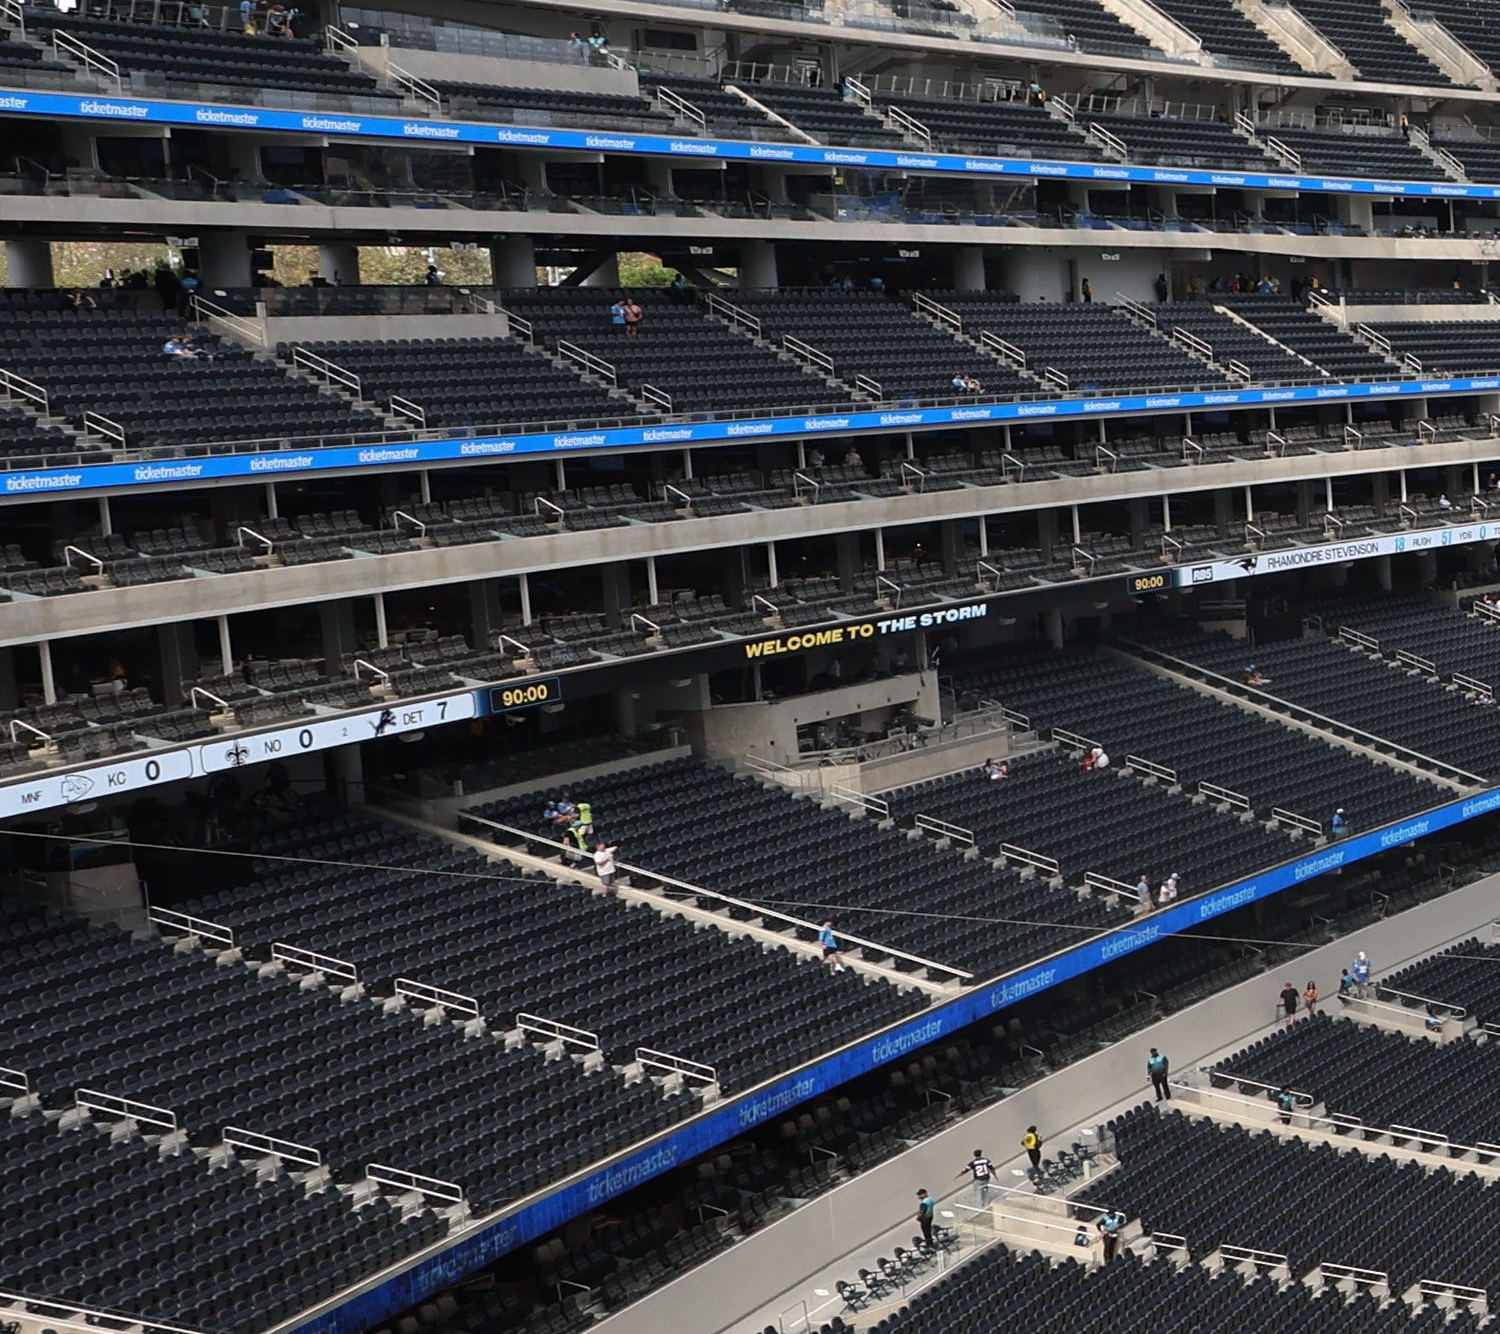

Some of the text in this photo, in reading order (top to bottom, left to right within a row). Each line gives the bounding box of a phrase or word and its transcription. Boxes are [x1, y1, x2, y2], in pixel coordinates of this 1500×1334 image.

[79, 100, 150, 118] ticketmaster
[669, 141, 718, 154] ticketmaster
[459, 441, 517, 455] ticketmaster
[249, 456, 314, 471] ticketmaster
[1394, 533, 1405, 552] 18
[1441, 530, 1452, 546] 51
[1479, 524, 1487, 540] 0
[1268, 541, 1379, 570] RHAMONDRE STEVENSON
[1135, 575, 1164, 590] 90:00
[745, 603, 987, 659] WELCOME TO THE STORM
[502, 684, 548, 706] 90:00
[403, 701, 448, 725] DET 7
[264, 728, 313, 754] NO 0
[341, 727, 348, 737] 2
[107, 760, 161, 787] KC 0
[21, 790, 43, 805] MNF
[1381, 819, 1430, 848] ticketmaster
[1199, 884, 1257, 919] ticketmaster
[871, 1018, 943, 1064] ticketmaster
[588, 1143, 678, 1204] ticketmaster
